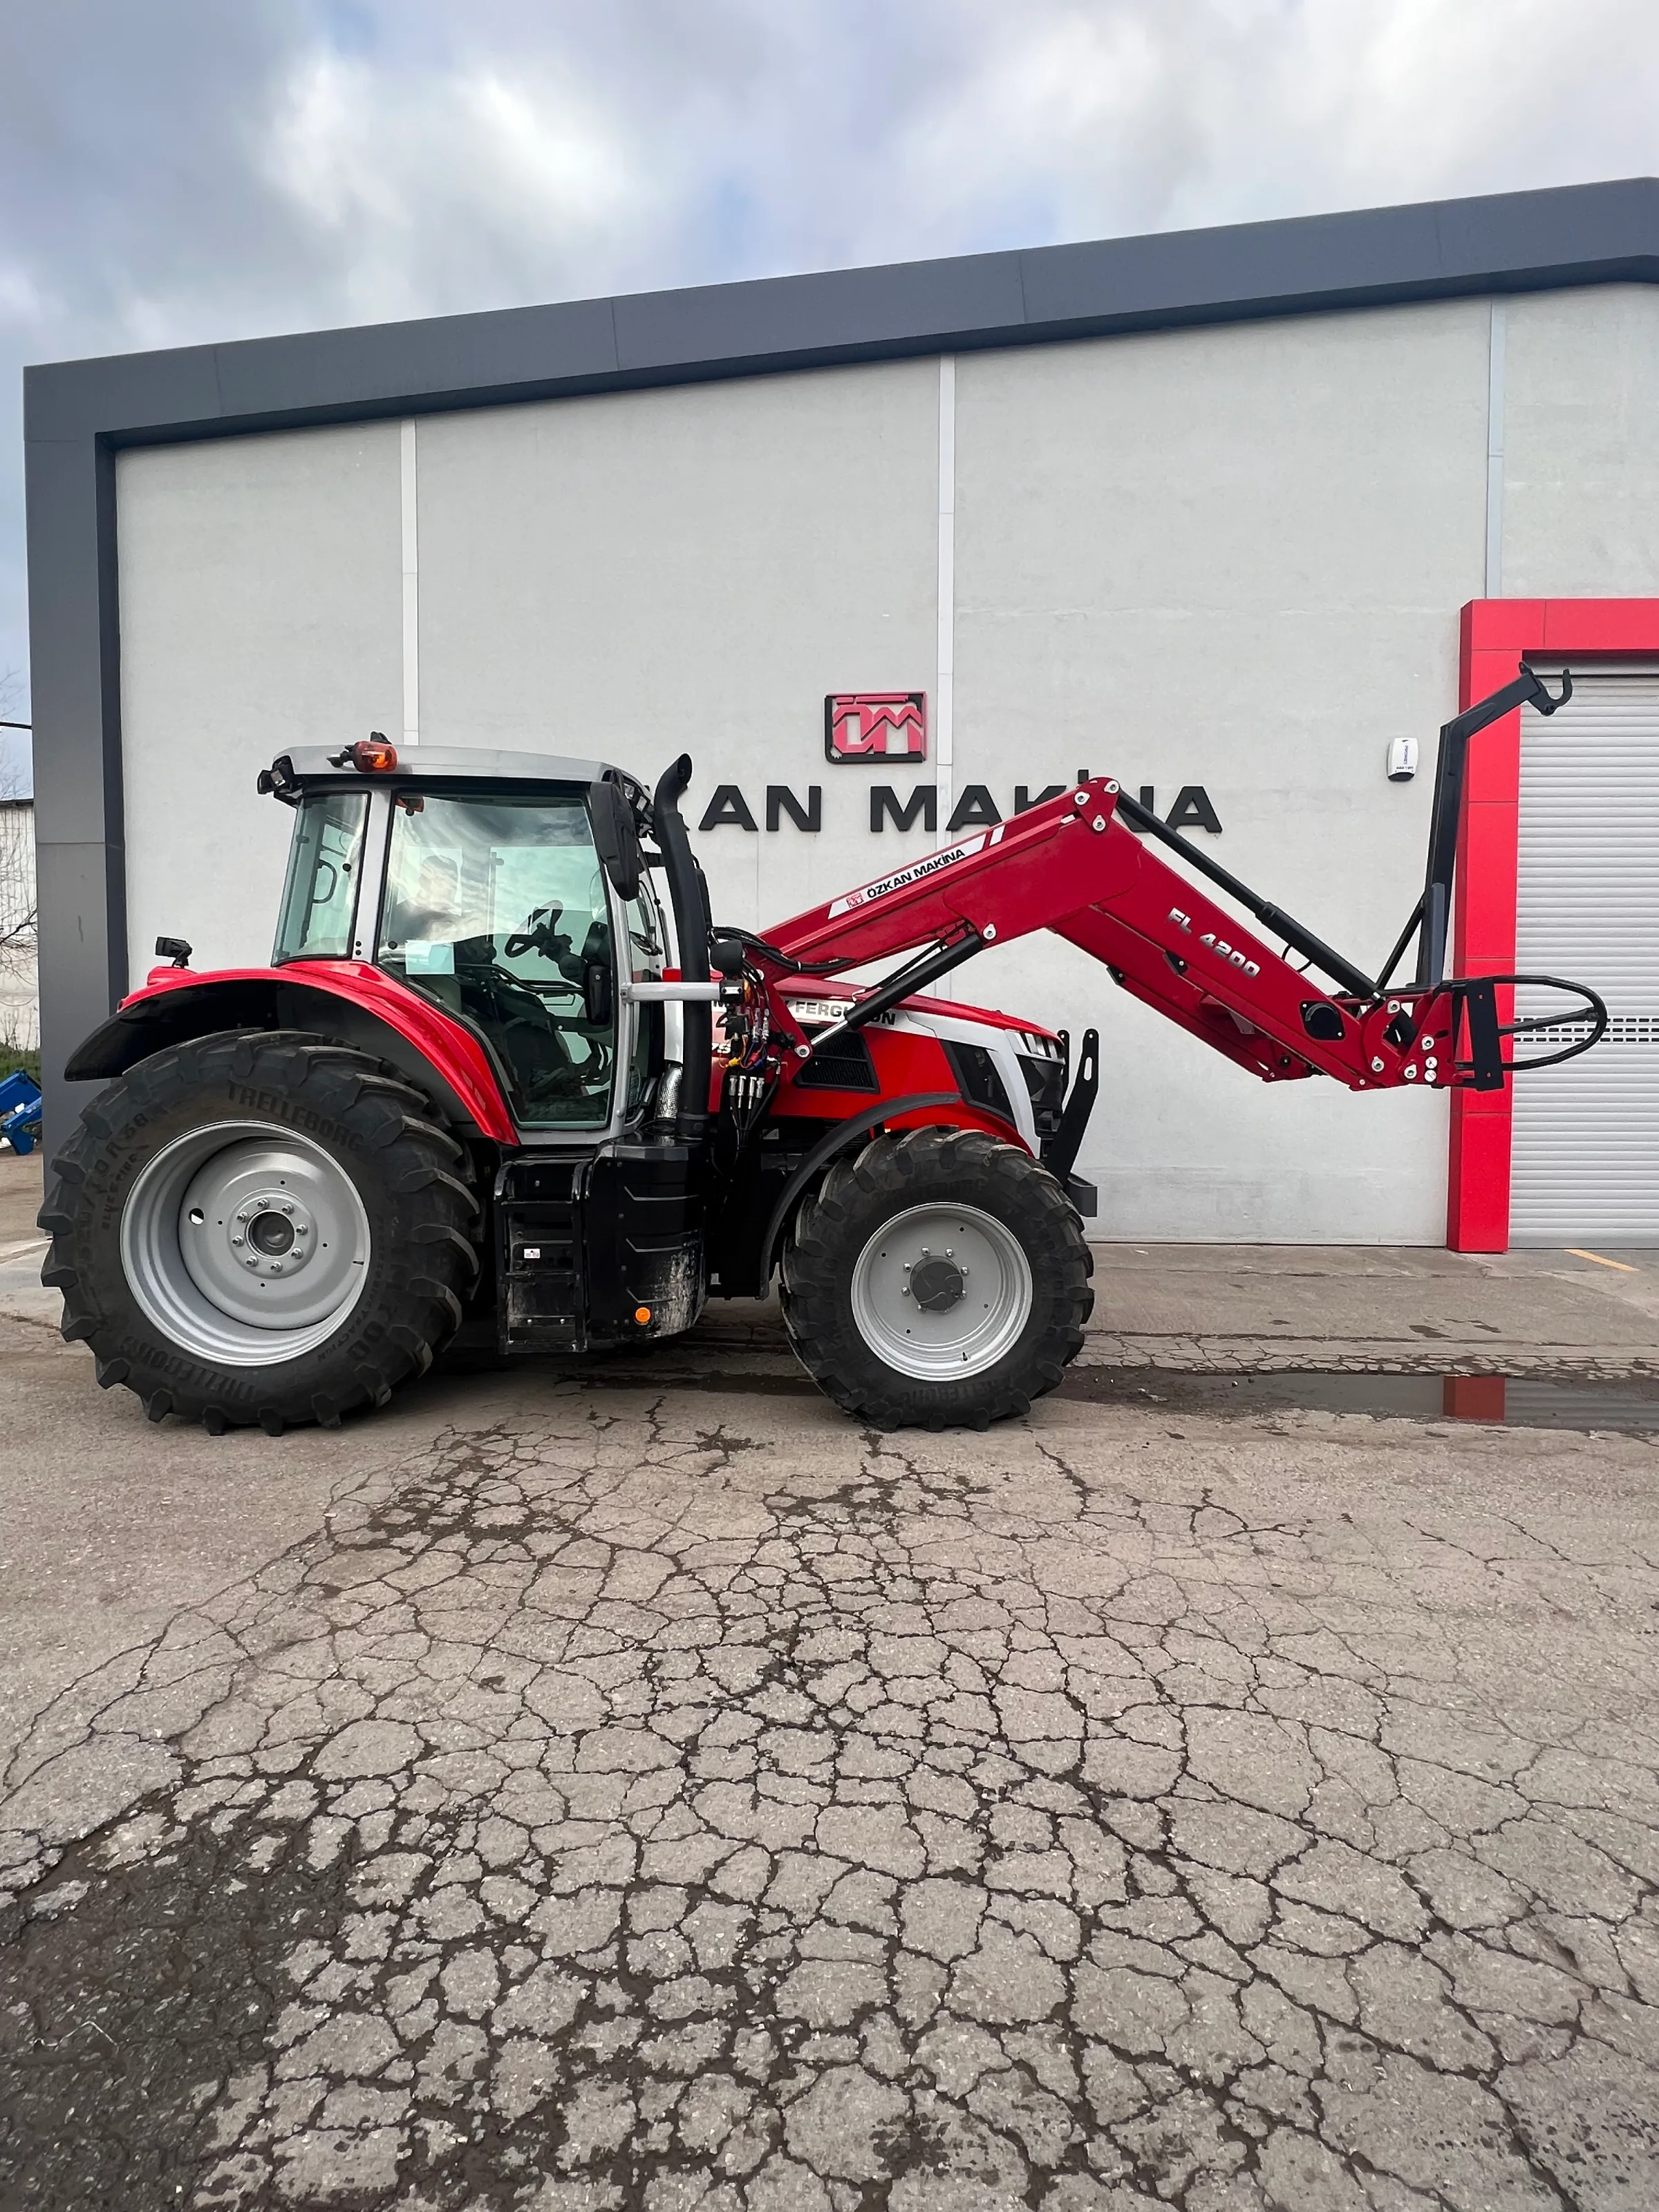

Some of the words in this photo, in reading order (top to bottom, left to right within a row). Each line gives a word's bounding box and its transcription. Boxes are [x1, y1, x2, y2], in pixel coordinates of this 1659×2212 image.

[698, 785, 821, 832] AN
[870, 769, 1223, 833] MAKA
[867, 872, 912, 898] ÖZKAN
[913, 848, 966, 878] MAKİNA
[1167, 907, 1192, 935] FL
[1199, 932, 1261, 979] 4200
[796, 1001, 896, 1025] FERGN
[227, 1079, 366, 1151] TRELLEBORG
